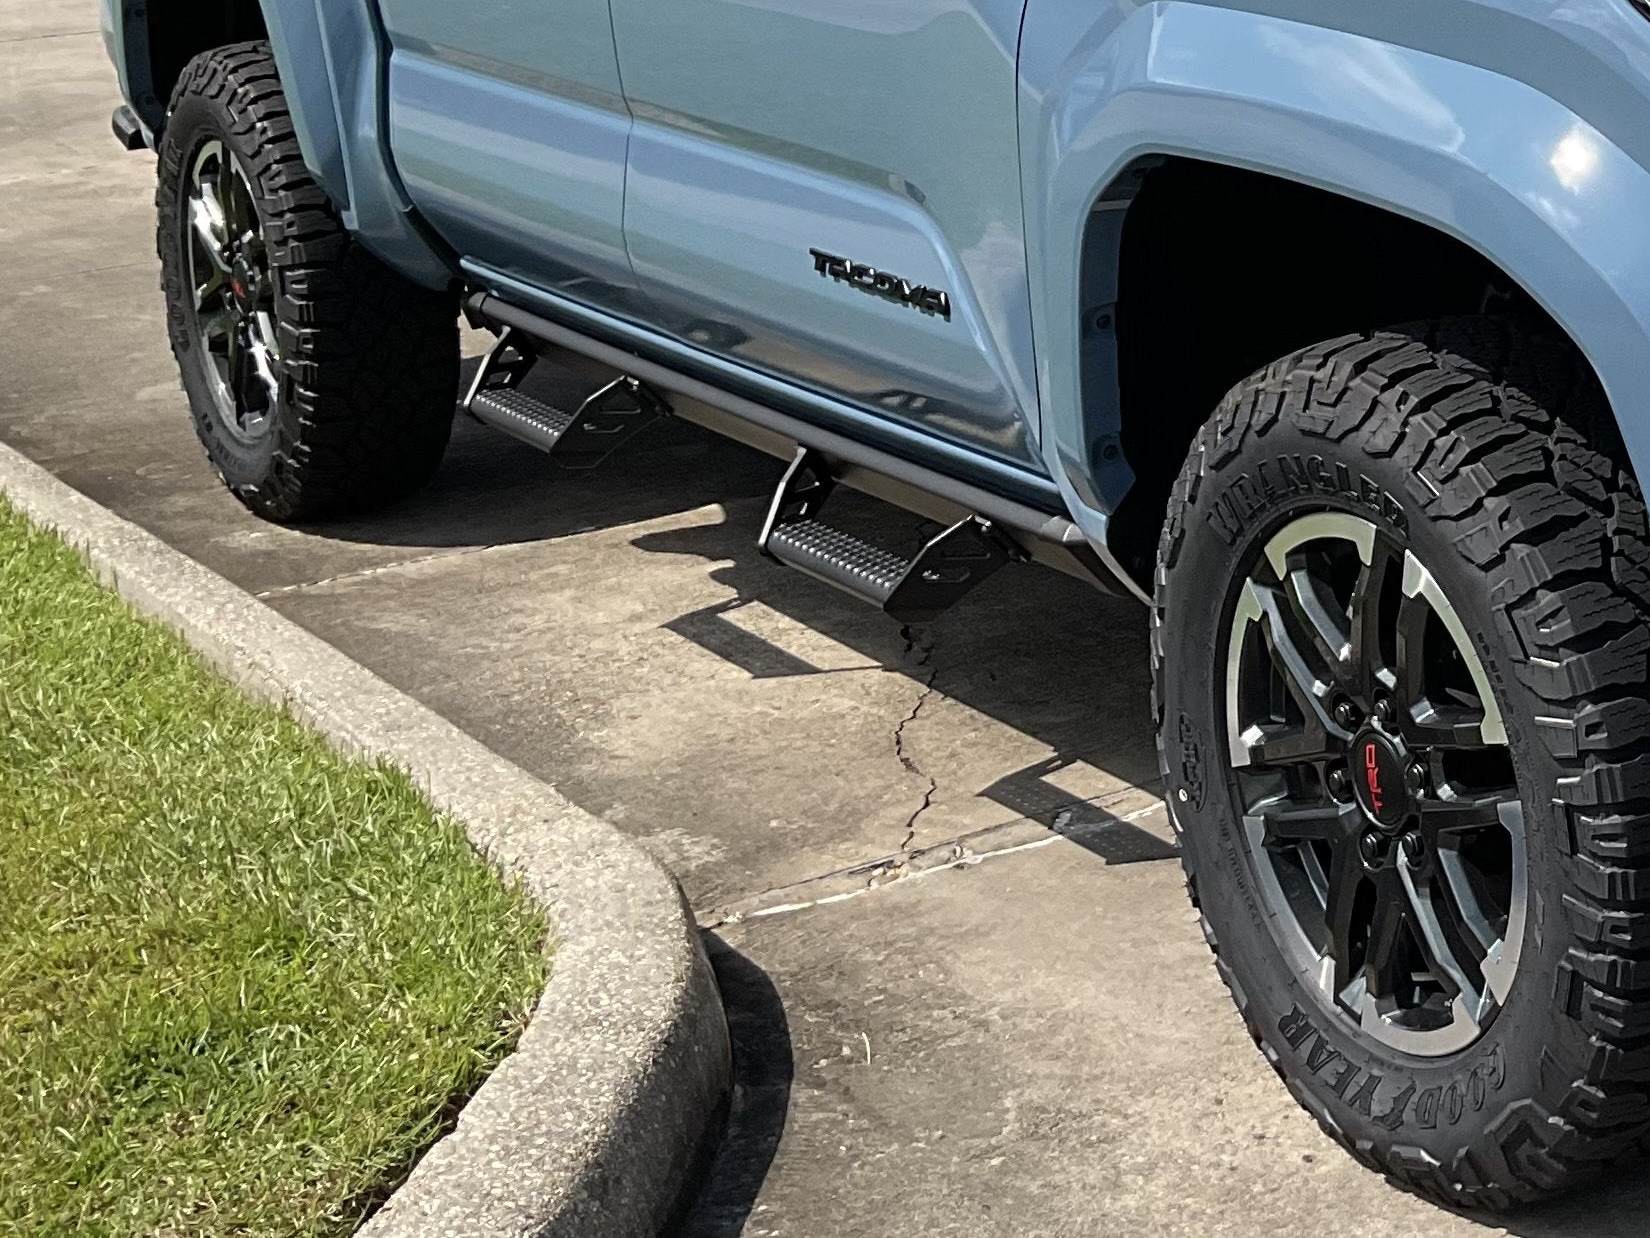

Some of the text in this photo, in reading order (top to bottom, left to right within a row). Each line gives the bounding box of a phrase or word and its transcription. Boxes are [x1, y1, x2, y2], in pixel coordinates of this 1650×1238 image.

[1206, 453, 1410, 546] WRANGLER
[1366, 744, 1382, 816] TRD
[1278, 1001, 1506, 1132] GOODYEAR
